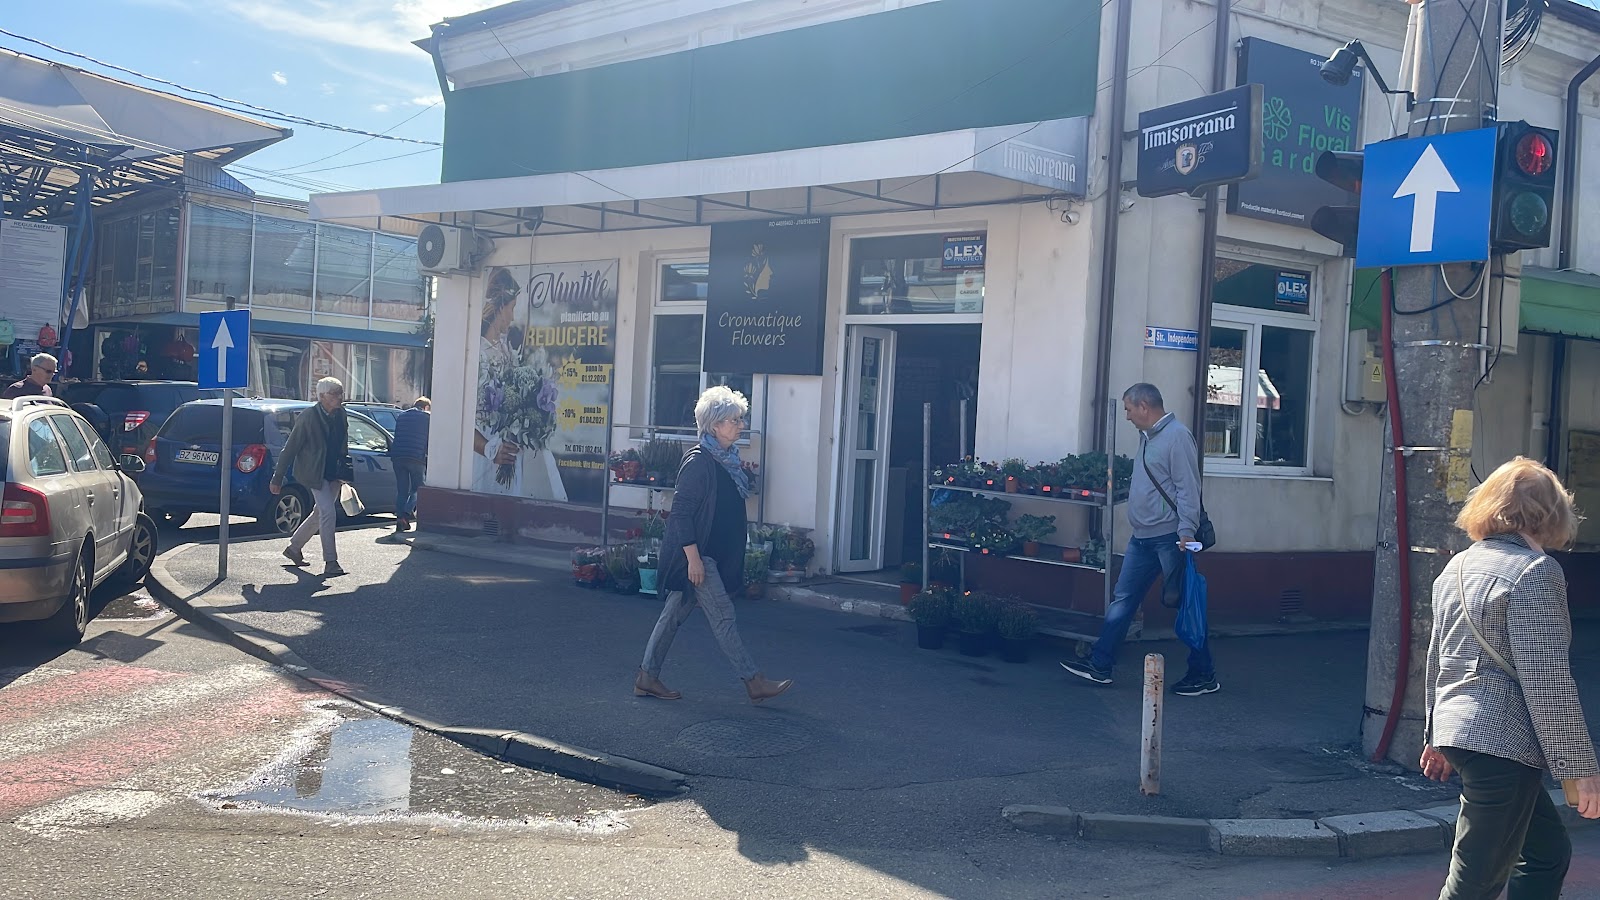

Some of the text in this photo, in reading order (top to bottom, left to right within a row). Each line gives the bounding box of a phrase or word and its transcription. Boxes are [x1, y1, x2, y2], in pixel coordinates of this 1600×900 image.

[1324, 105, 1351, 132] Vis
[1142, 107, 1237, 151] Timișoreana
[1298, 124, 1350, 151] Floral
[13, 221, 54, 231] REGULAMENT
[954, 245, 983, 256] LEX
[529, 269, 611, 308] Nuntile
[1285, 281, 1308, 294] LEX
[560, 311, 609, 323] planificate au
[718, 310, 802, 332] Cromatique
[525, 325, 609, 347] REDUCERE
[731, 329, 786, 346] Flowers
[1156, 331, 1165, 342] Str.
[564, 368, 578, 377] -15%
[598, 364, 603, 372] la
[581, 374, 607, 383] 01.12.2020
[562, 408, 576, 418] -10%
[579, 415, 605, 424] 01.04.2021
[180, 450, 190, 459] BZ
